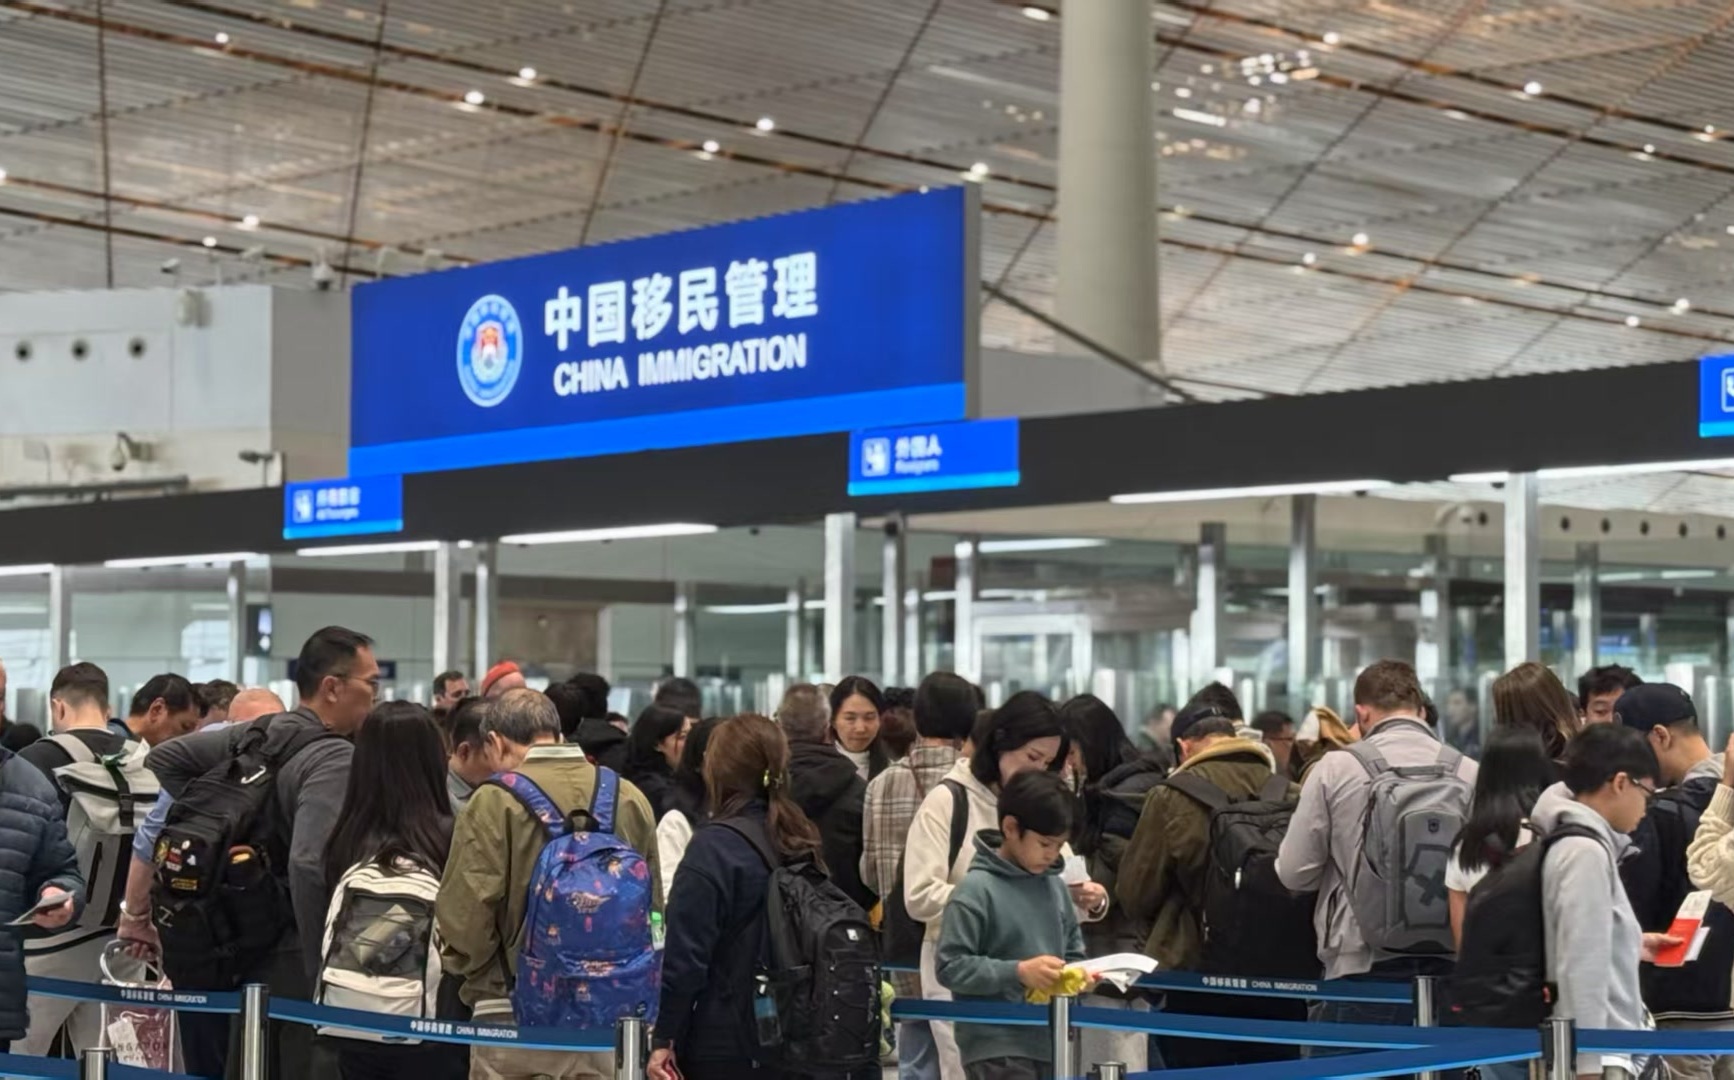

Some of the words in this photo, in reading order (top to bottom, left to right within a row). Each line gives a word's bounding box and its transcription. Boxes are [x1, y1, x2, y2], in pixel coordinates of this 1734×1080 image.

[544, 251, 819, 351] 中国移民管理
[553, 356, 629, 396] CHINA
[638, 332, 807, 387] IMMIGRATION
